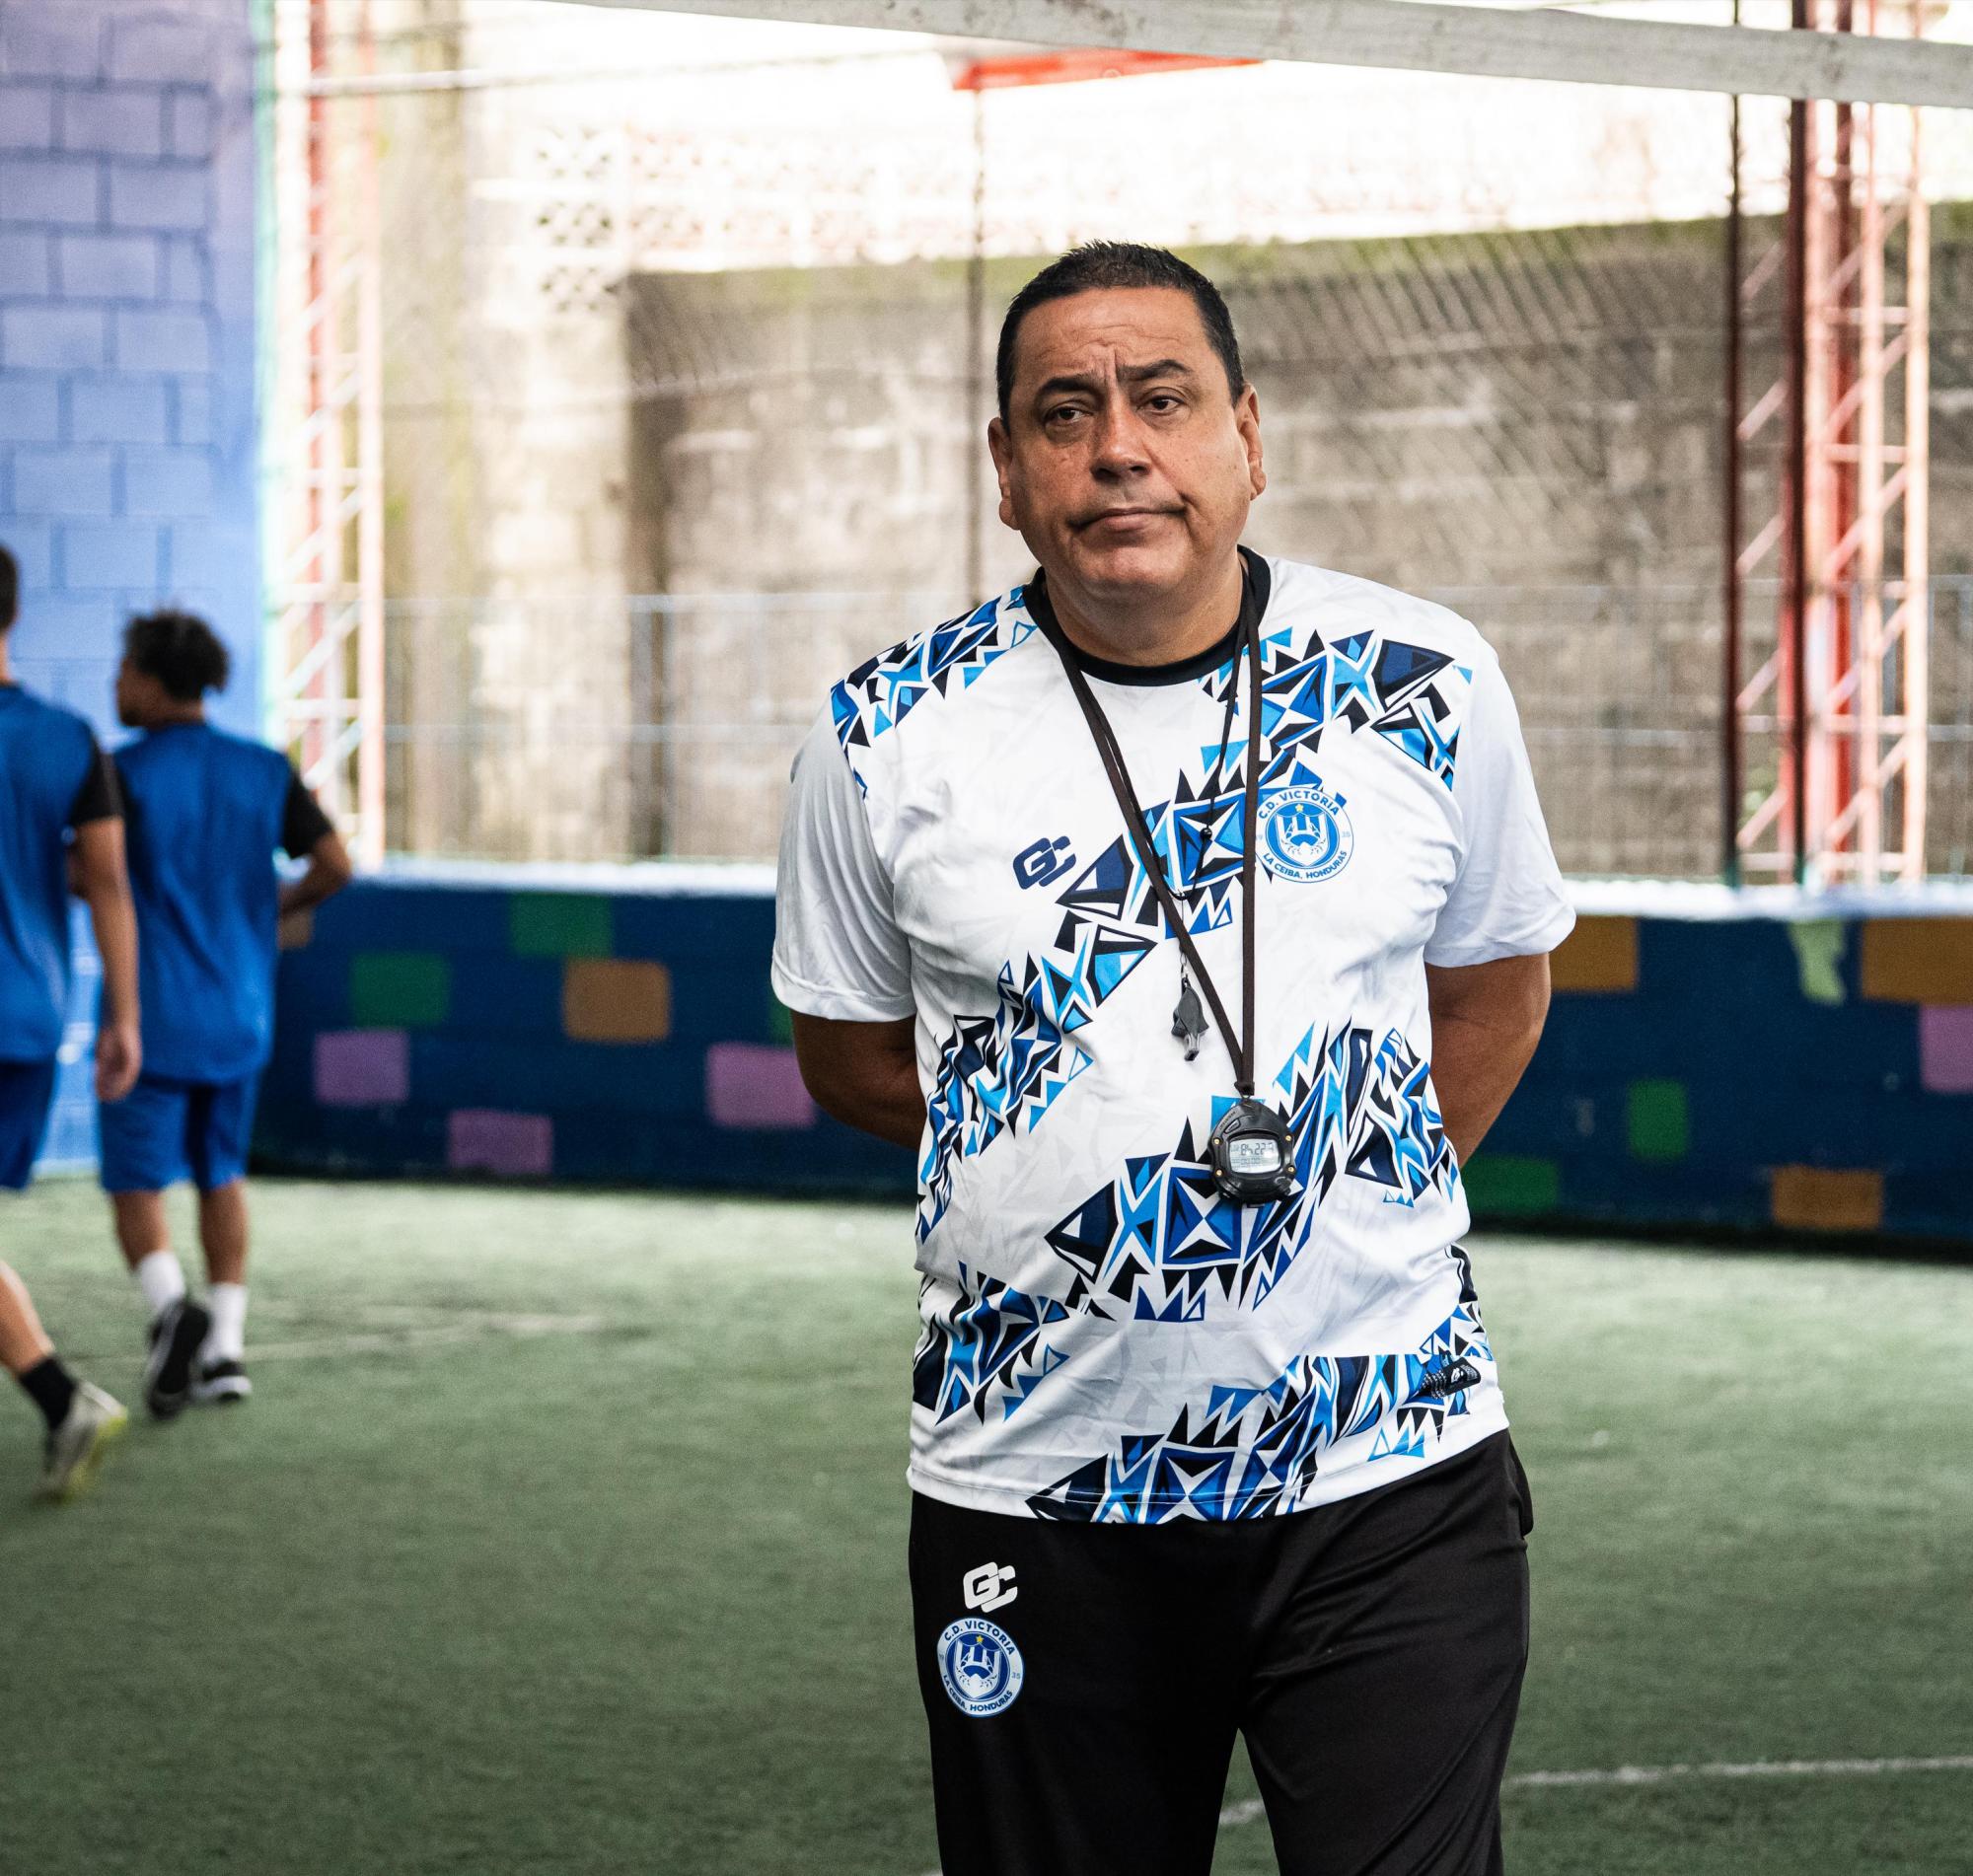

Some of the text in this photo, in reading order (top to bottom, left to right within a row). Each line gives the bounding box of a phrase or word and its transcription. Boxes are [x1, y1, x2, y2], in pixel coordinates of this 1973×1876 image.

[1258, 790, 1340, 819] C.D. VICTORIA
[1013, 835, 1076, 890] GC
[1263, 852, 1274, 865] LA
[1305, 850, 1347, 879] HONDURAS
[963, 1561, 1018, 1613] GC
[944, 1621, 1015, 1655] C.D. VICTORIA
[970, 1690, 1013, 1712] HONDURAS
